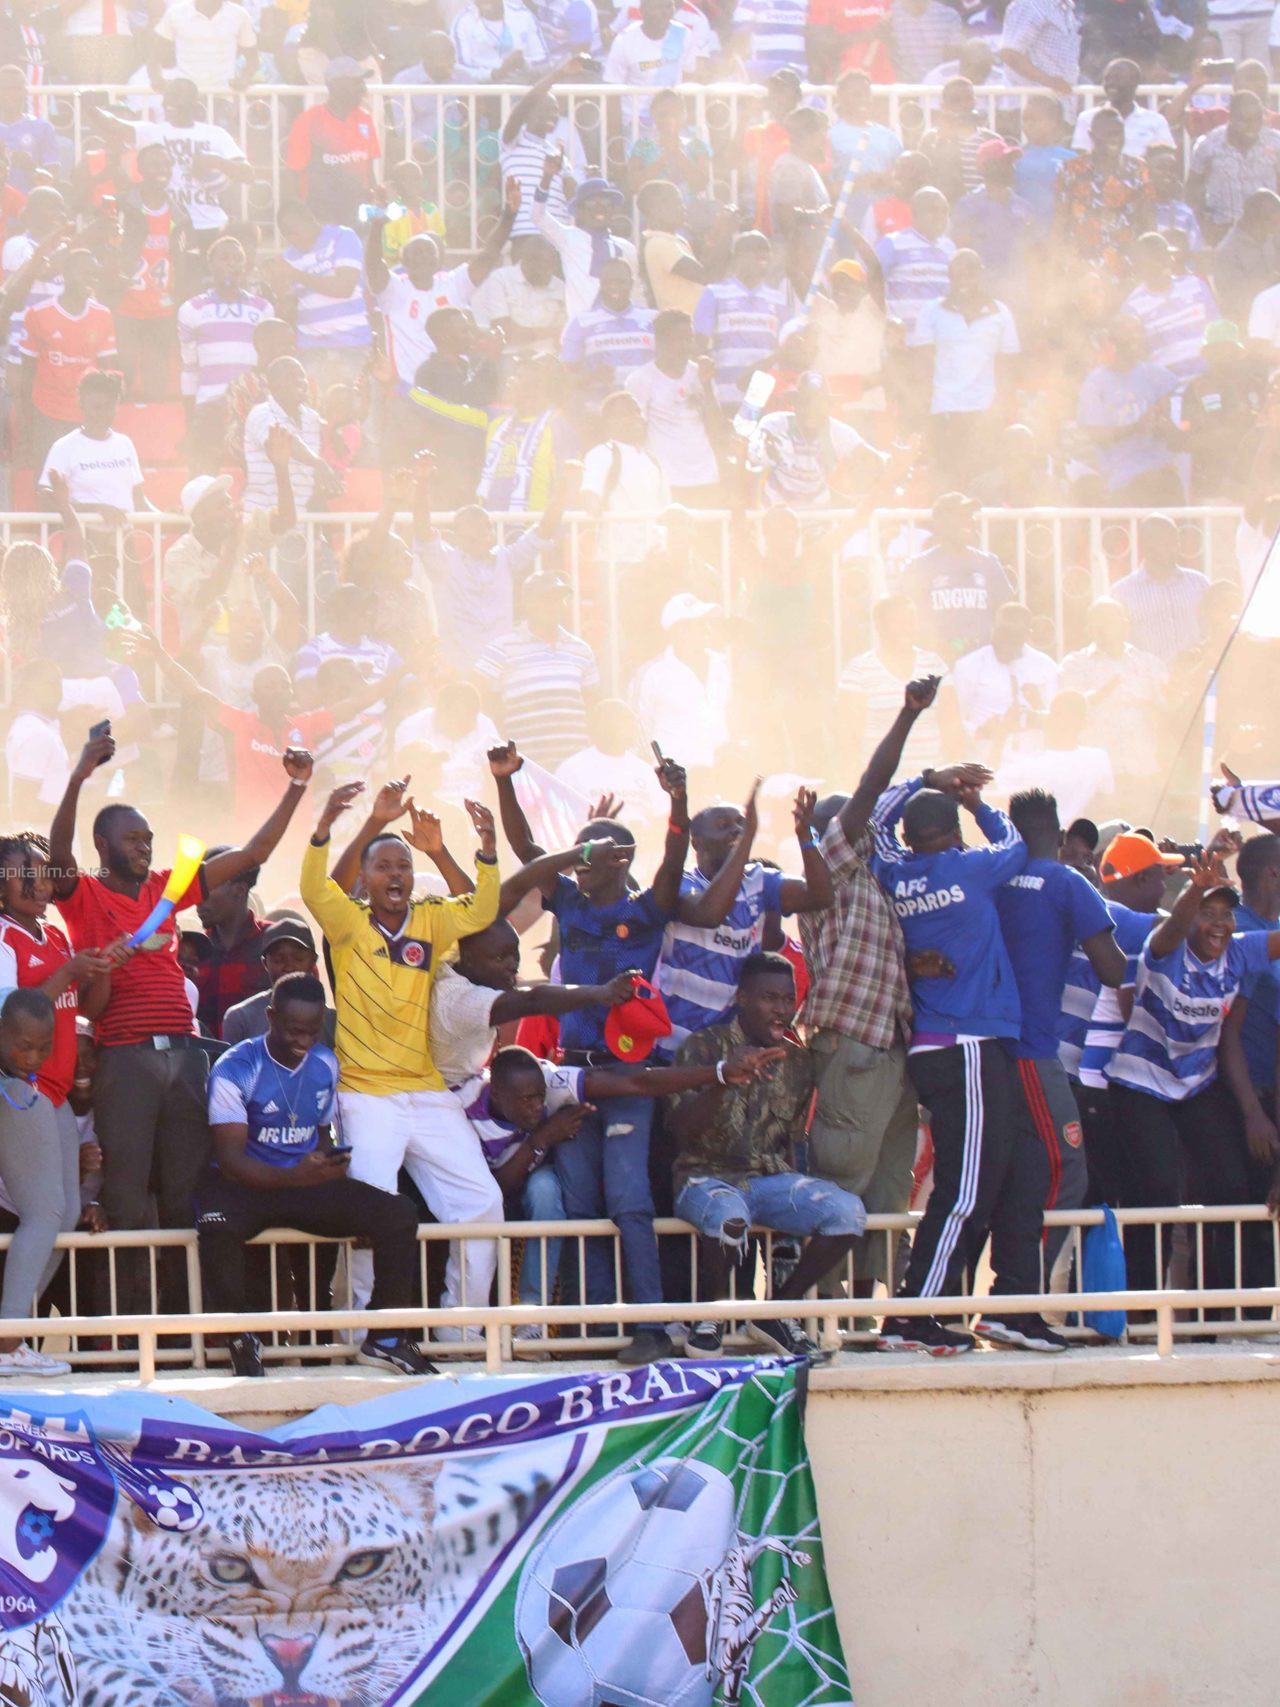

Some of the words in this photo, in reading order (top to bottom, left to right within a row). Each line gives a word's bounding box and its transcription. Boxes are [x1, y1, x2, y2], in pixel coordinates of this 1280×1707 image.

[930, 588, 988, 610] INGWE
[894, 875, 927, 899] AFC
[894, 884, 965, 918] OPARDS
[257, 1126, 280, 1144] AFC
